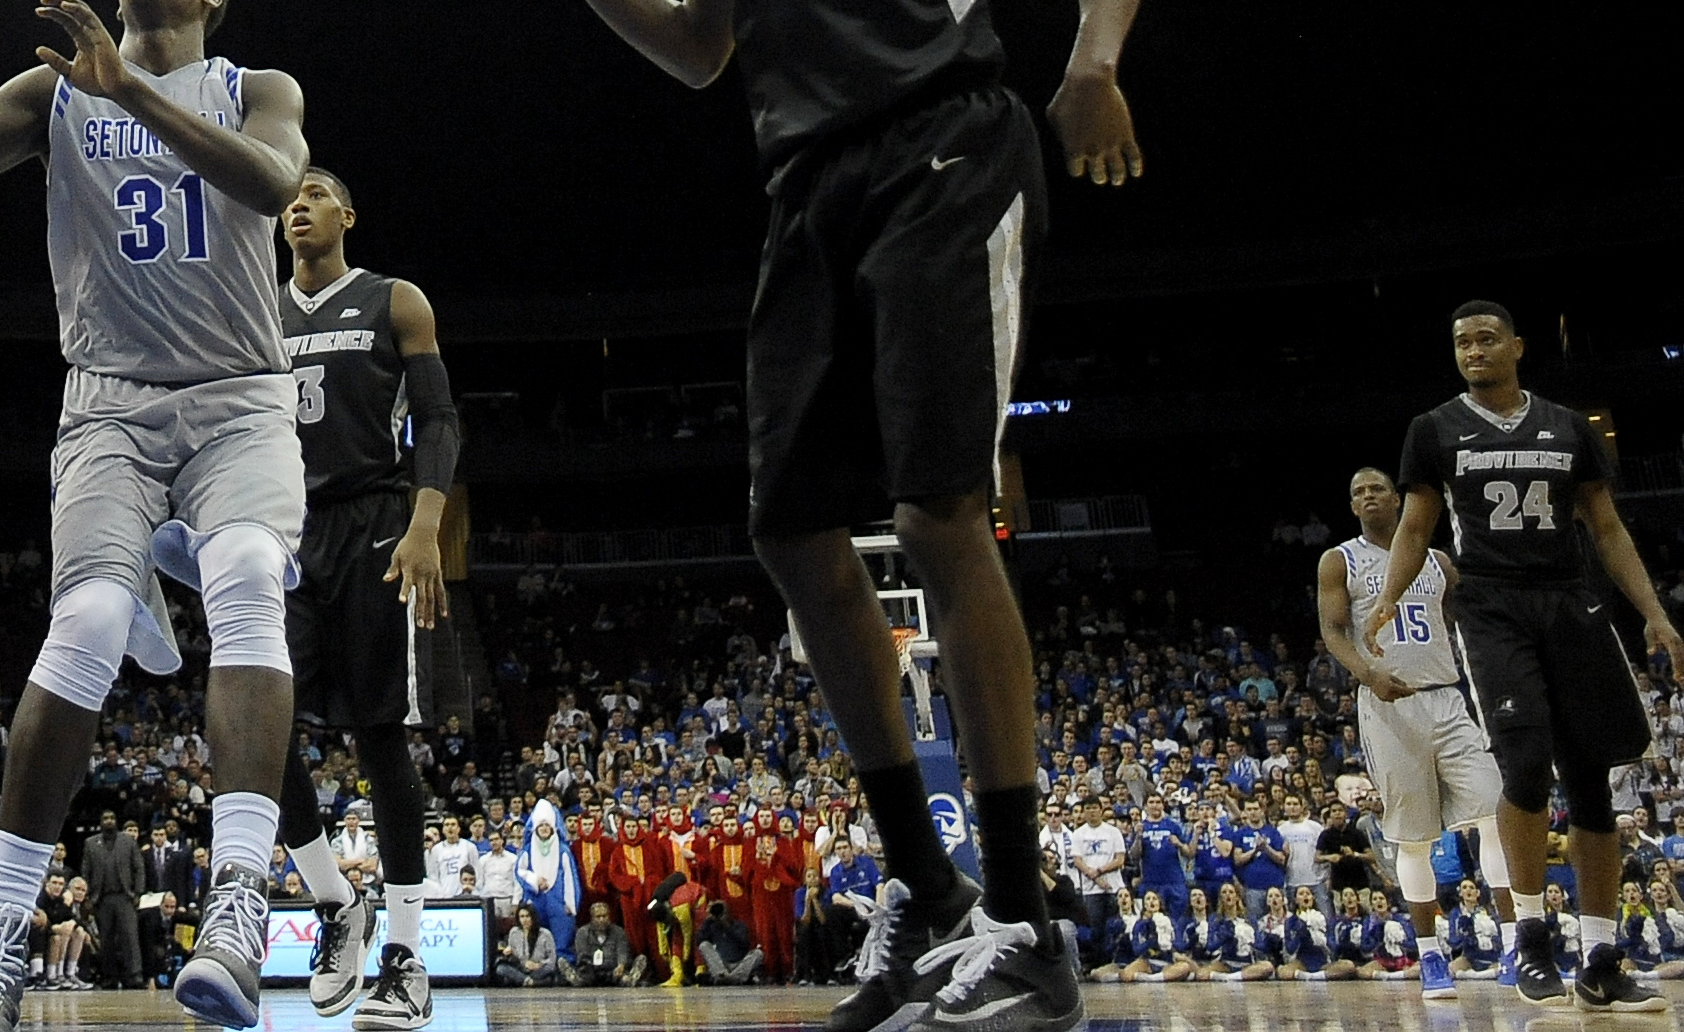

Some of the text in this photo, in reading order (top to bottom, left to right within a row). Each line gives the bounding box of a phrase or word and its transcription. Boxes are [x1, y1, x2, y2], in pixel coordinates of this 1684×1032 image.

[113, 170, 211, 264] 31
[1455, 449, 1573, 477] PROVIDENCE
[1483, 480, 1557, 530] 24
[1392, 601, 1433, 646] 15
